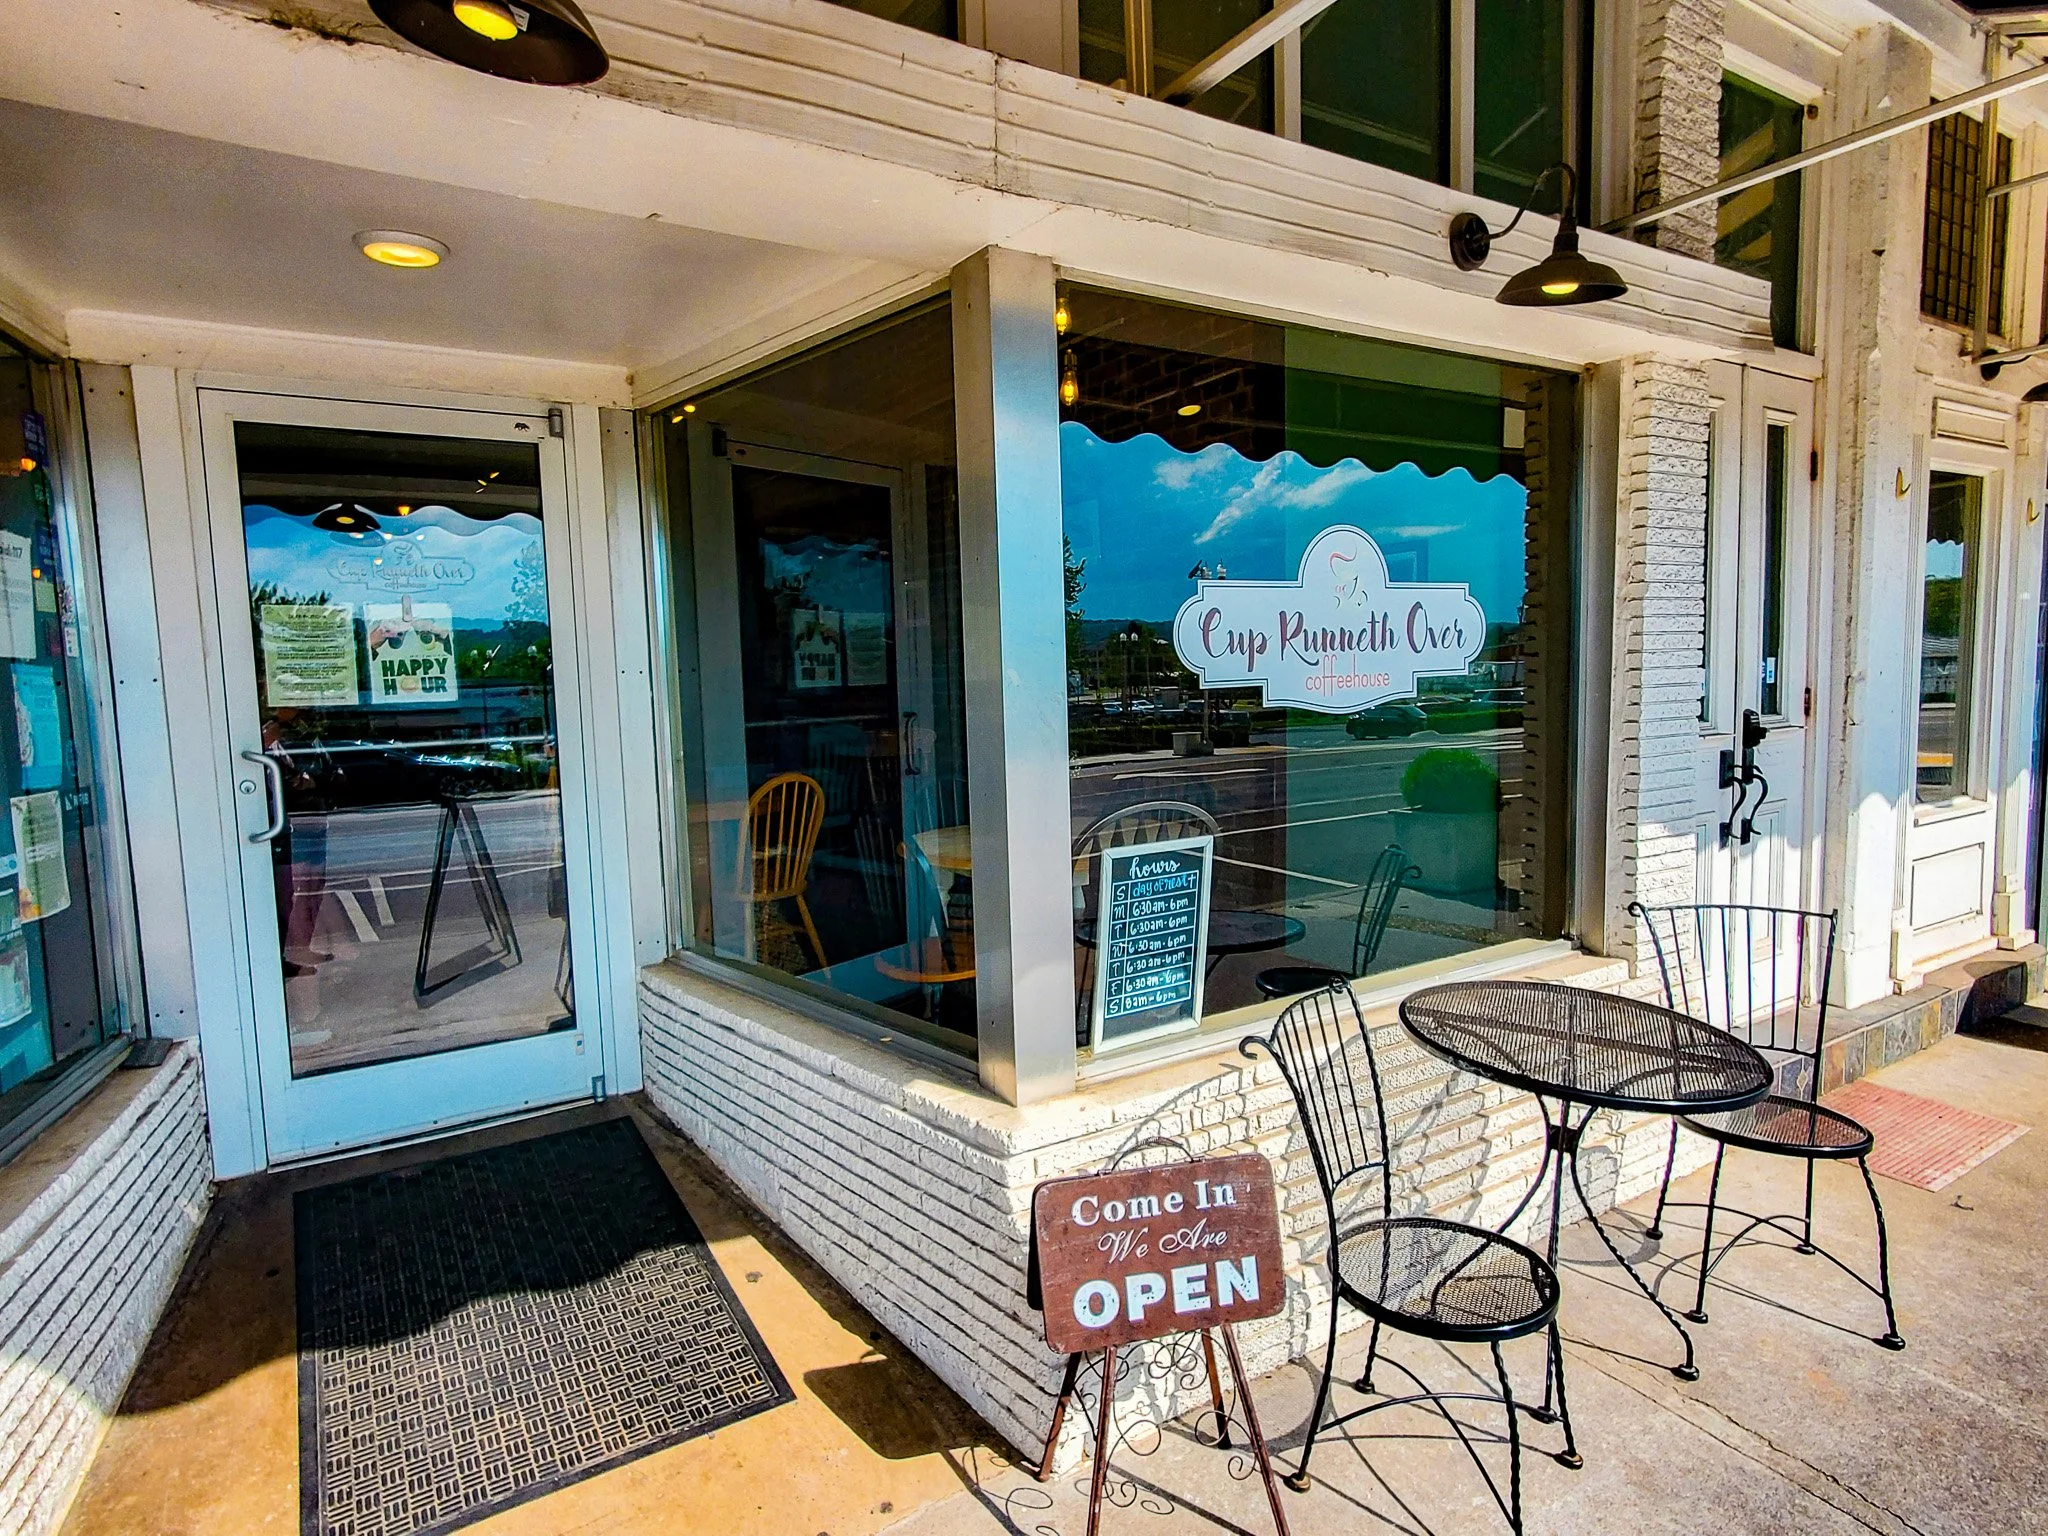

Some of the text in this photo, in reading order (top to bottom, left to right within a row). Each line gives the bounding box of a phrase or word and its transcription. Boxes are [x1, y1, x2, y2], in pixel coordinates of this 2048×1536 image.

[1198, 601, 1468, 672] Cup Runneth Over
[381, 658, 449, 677] HAPPY
[1305, 654, 1390, 697] coffeehouse
[1129, 856, 1181, 880] hours
[1117, 885, 1126, 900] S
[1133, 882, 1153, 897] day
[1164, 874, 1189, 890] rest
[1114, 905, 1126, 919] M
[1115, 924, 1123, 939] T
[1112, 963, 1121, 977] T
[1111, 981, 1121, 995] F
[1110, 999, 1119, 1014] S
[1071, 1179, 1237, 1227] Come In
[1098, 1217, 1229, 1264] We Are
[1072, 1255, 1261, 1329] OPEN
